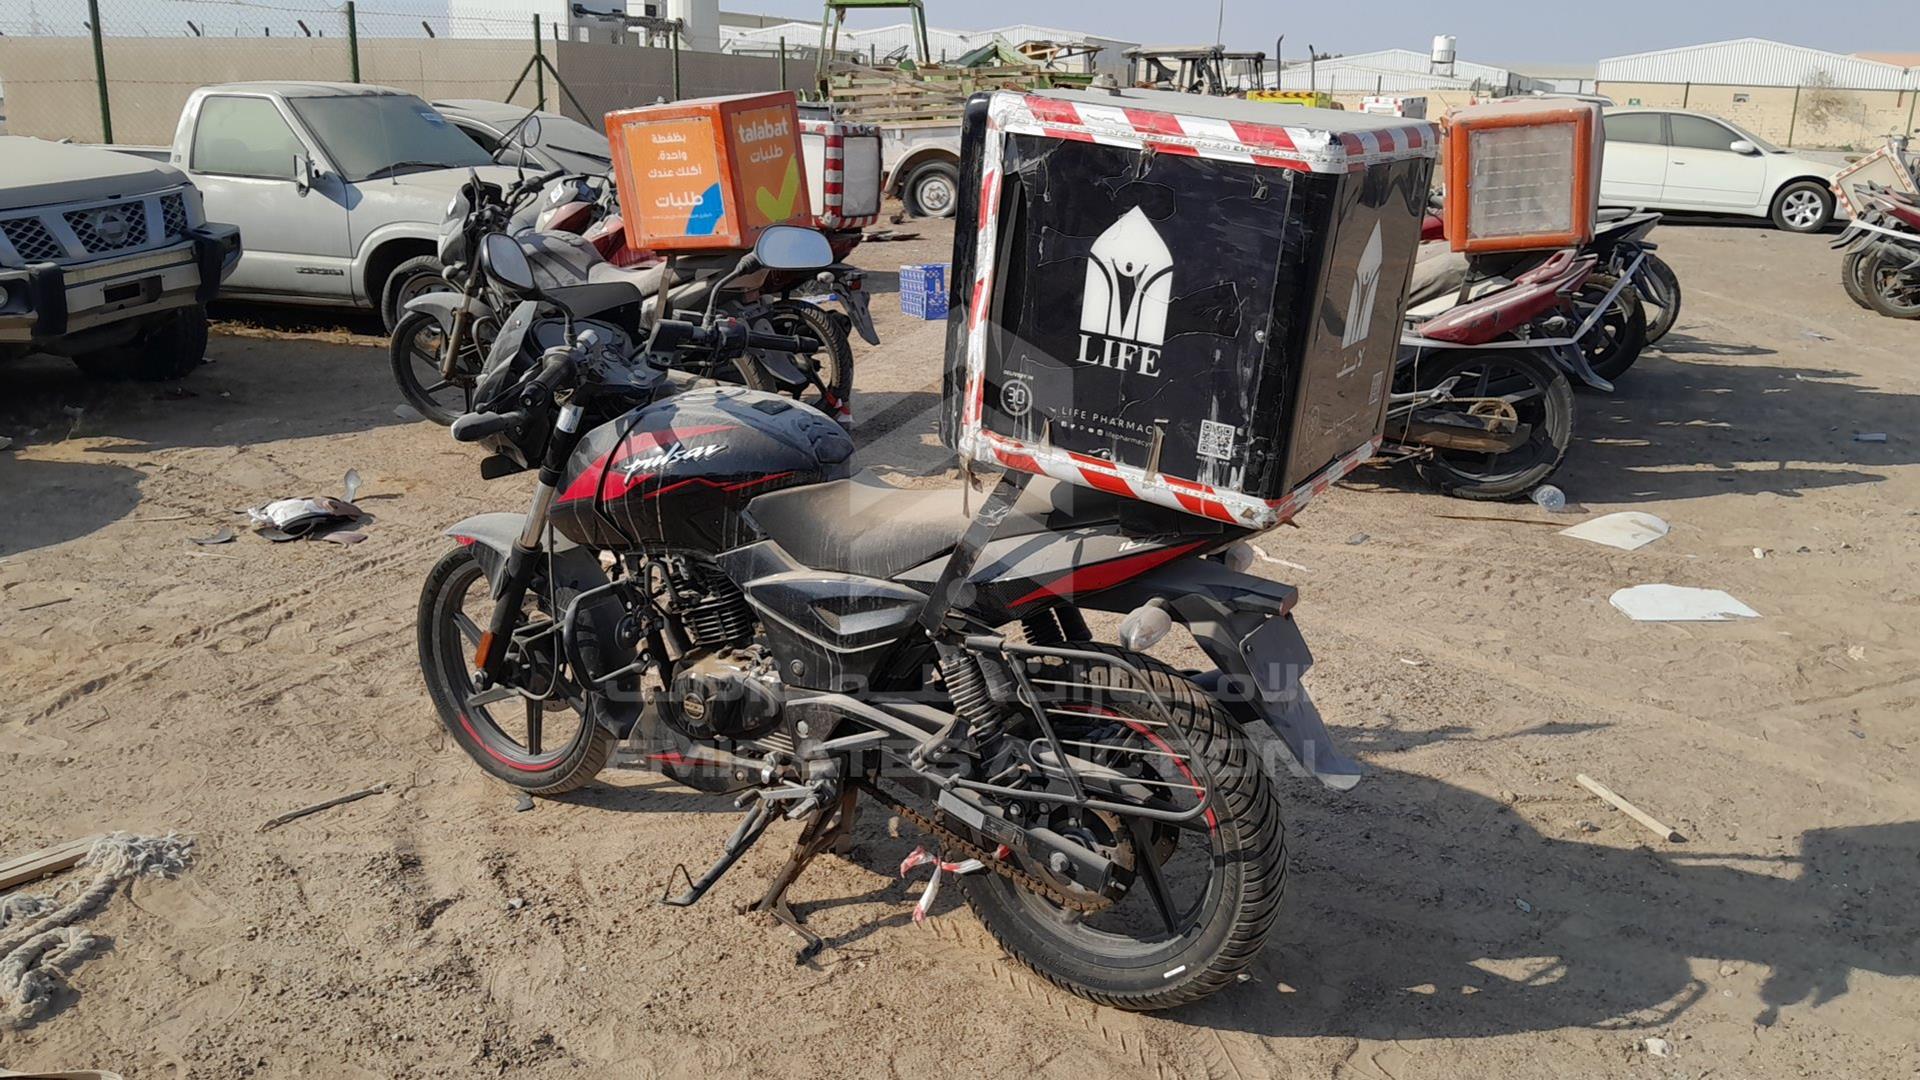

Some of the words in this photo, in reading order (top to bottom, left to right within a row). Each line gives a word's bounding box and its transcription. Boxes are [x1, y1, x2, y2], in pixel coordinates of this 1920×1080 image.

[738, 117, 789, 143] talabat
[750, 144, 784, 163] طلبات
[655, 191, 704, 210] طلبات
[1076, 333, 1161, 377] LIFE
[1008, 387, 1025, 405] 30
[1062, 406, 1087, 420] LIFE
[1092, 413, 1153, 435] PHARMAC
[624, 442, 728, 484] pulsar
